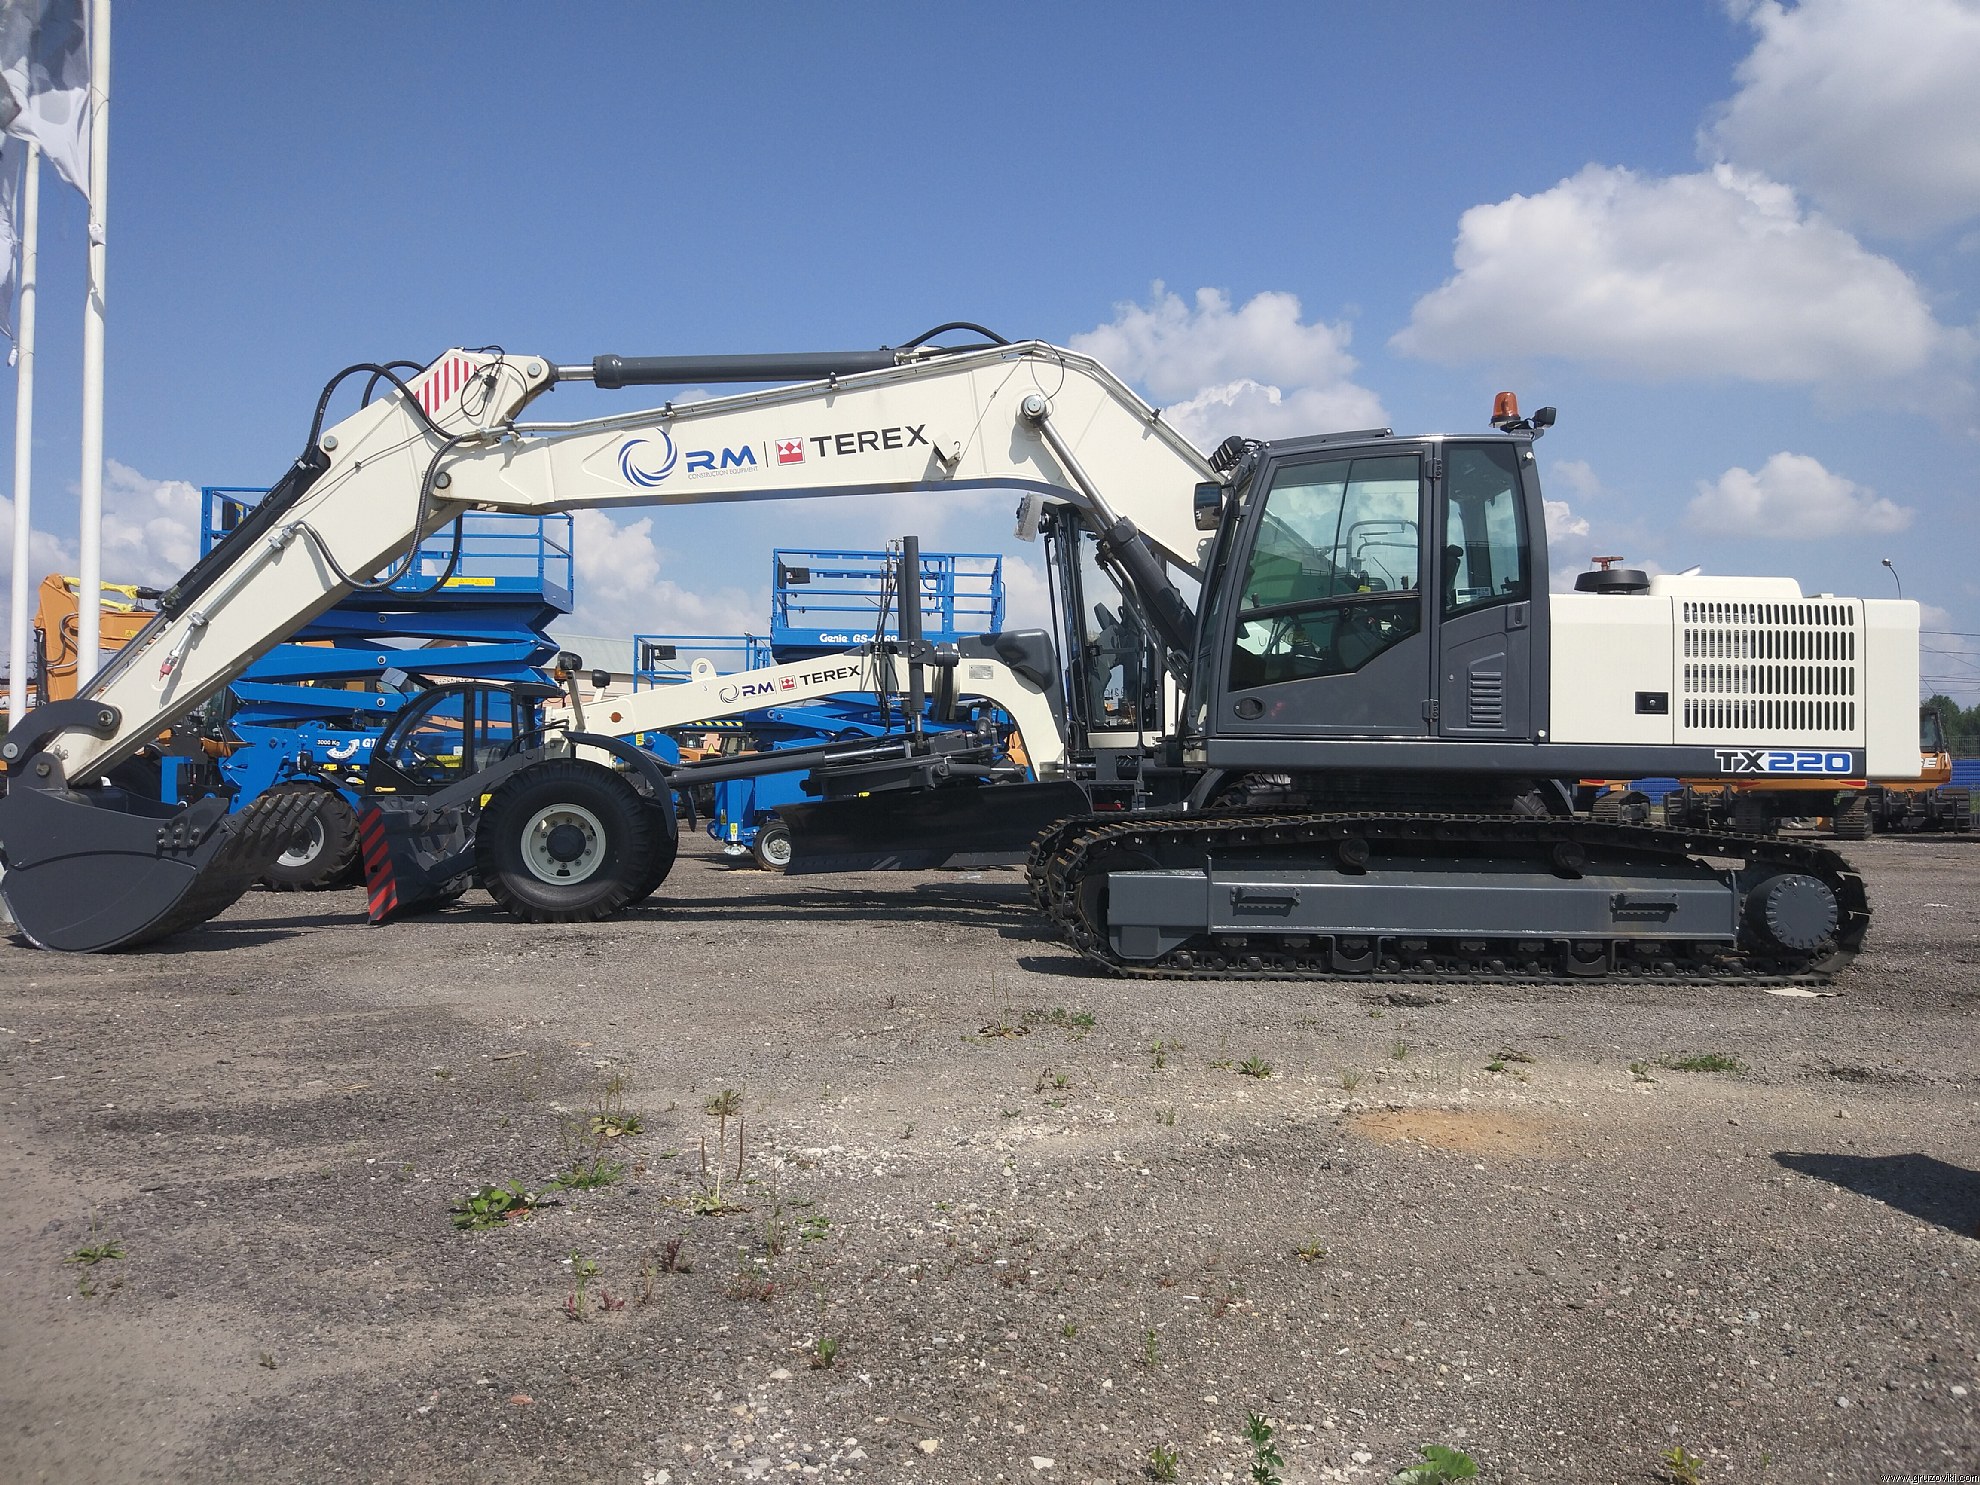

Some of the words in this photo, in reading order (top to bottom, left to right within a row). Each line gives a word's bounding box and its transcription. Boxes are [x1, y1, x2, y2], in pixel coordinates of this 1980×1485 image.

[685, 445, 757, 473] RM
[810, 424, 929, 457] TEREX
[688, 468, 728, 480] CONSTRUCTION
[729, 465, 759, 475] EQUIPMENT
[819, 633, 848, 643] Genie
[742, 681, 775, 697] RM
[799, 664, 860, 686] TEREX
[1715, 750, 1851, 773] TX220
